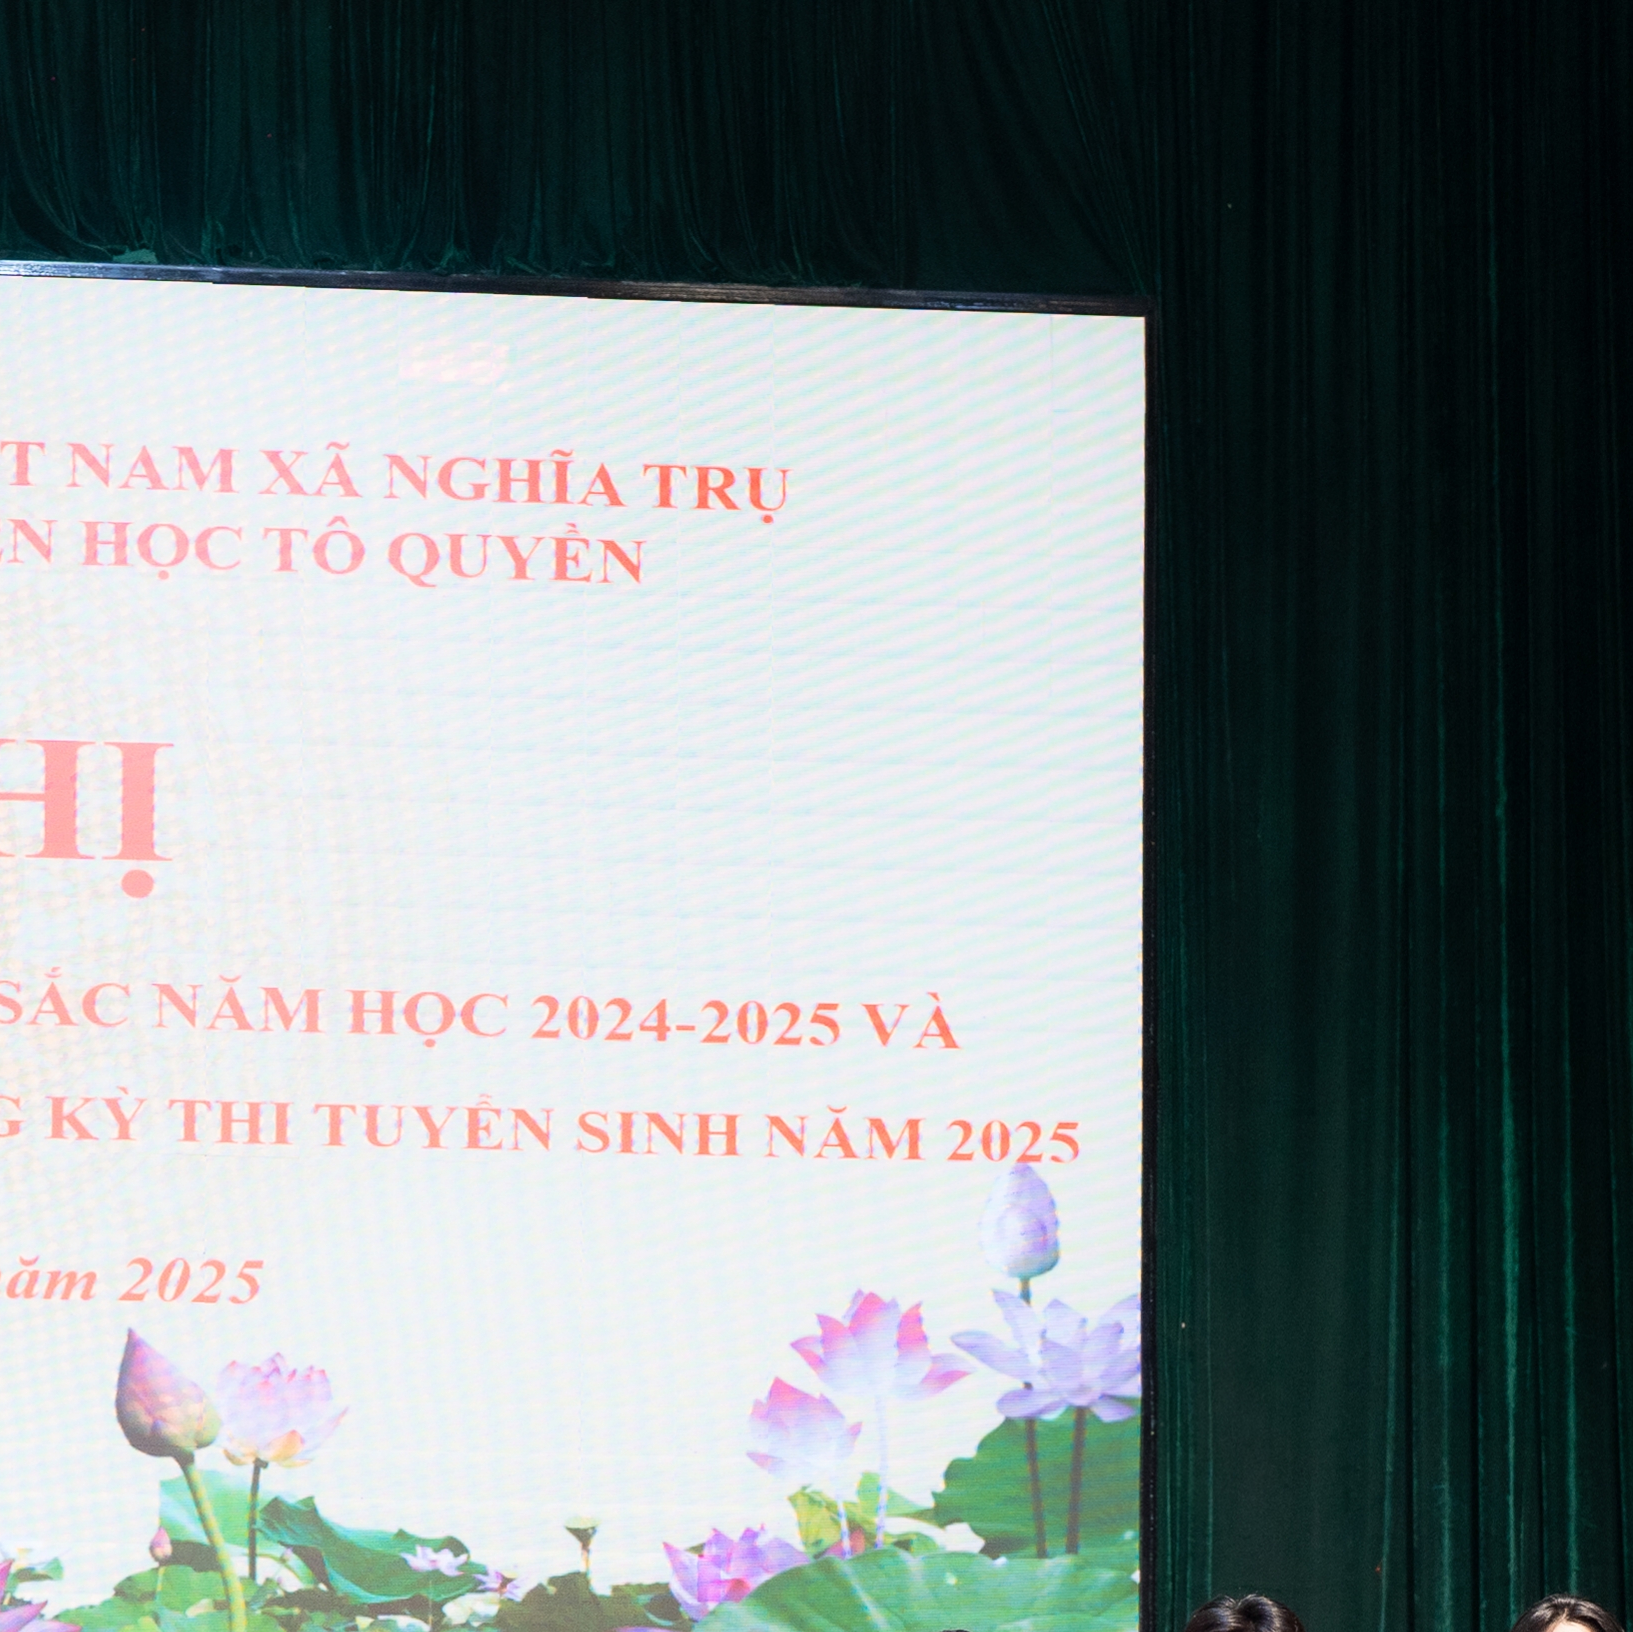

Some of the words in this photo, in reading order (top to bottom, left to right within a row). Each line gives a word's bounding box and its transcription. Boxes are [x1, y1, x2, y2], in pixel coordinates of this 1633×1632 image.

[68, 440, 236, 493] NAM
[263, 442, 362, 497] XÃ
[384, 449, 626, 509] NGHĨA
[643, 464, 791, 524] TRỤ
[81, 522, 241, 579] HỌC
[264, 516, 365, 577] TÔ
[387, 523, 646, 587] QUYỀN
[153, 975, 322, 1034] NĂM
[348, 990, 509, 1048] HỌC
[531, 993, 842, 1047] 2024-2025
[862, 990, 961, 1050] VÀ
[46, 1083, 145, 1144] KỲ
[169, 1098, 291, 1147] THI
[315, 1088, 554, 1153] TUYỂN
[575, 1110, 741, 1158] SINH
[764, 1107, 924, 1162] NĂM
[946, 1120, 1080, 1166] 2025
[119, 1257, 264, 1305] 2025
